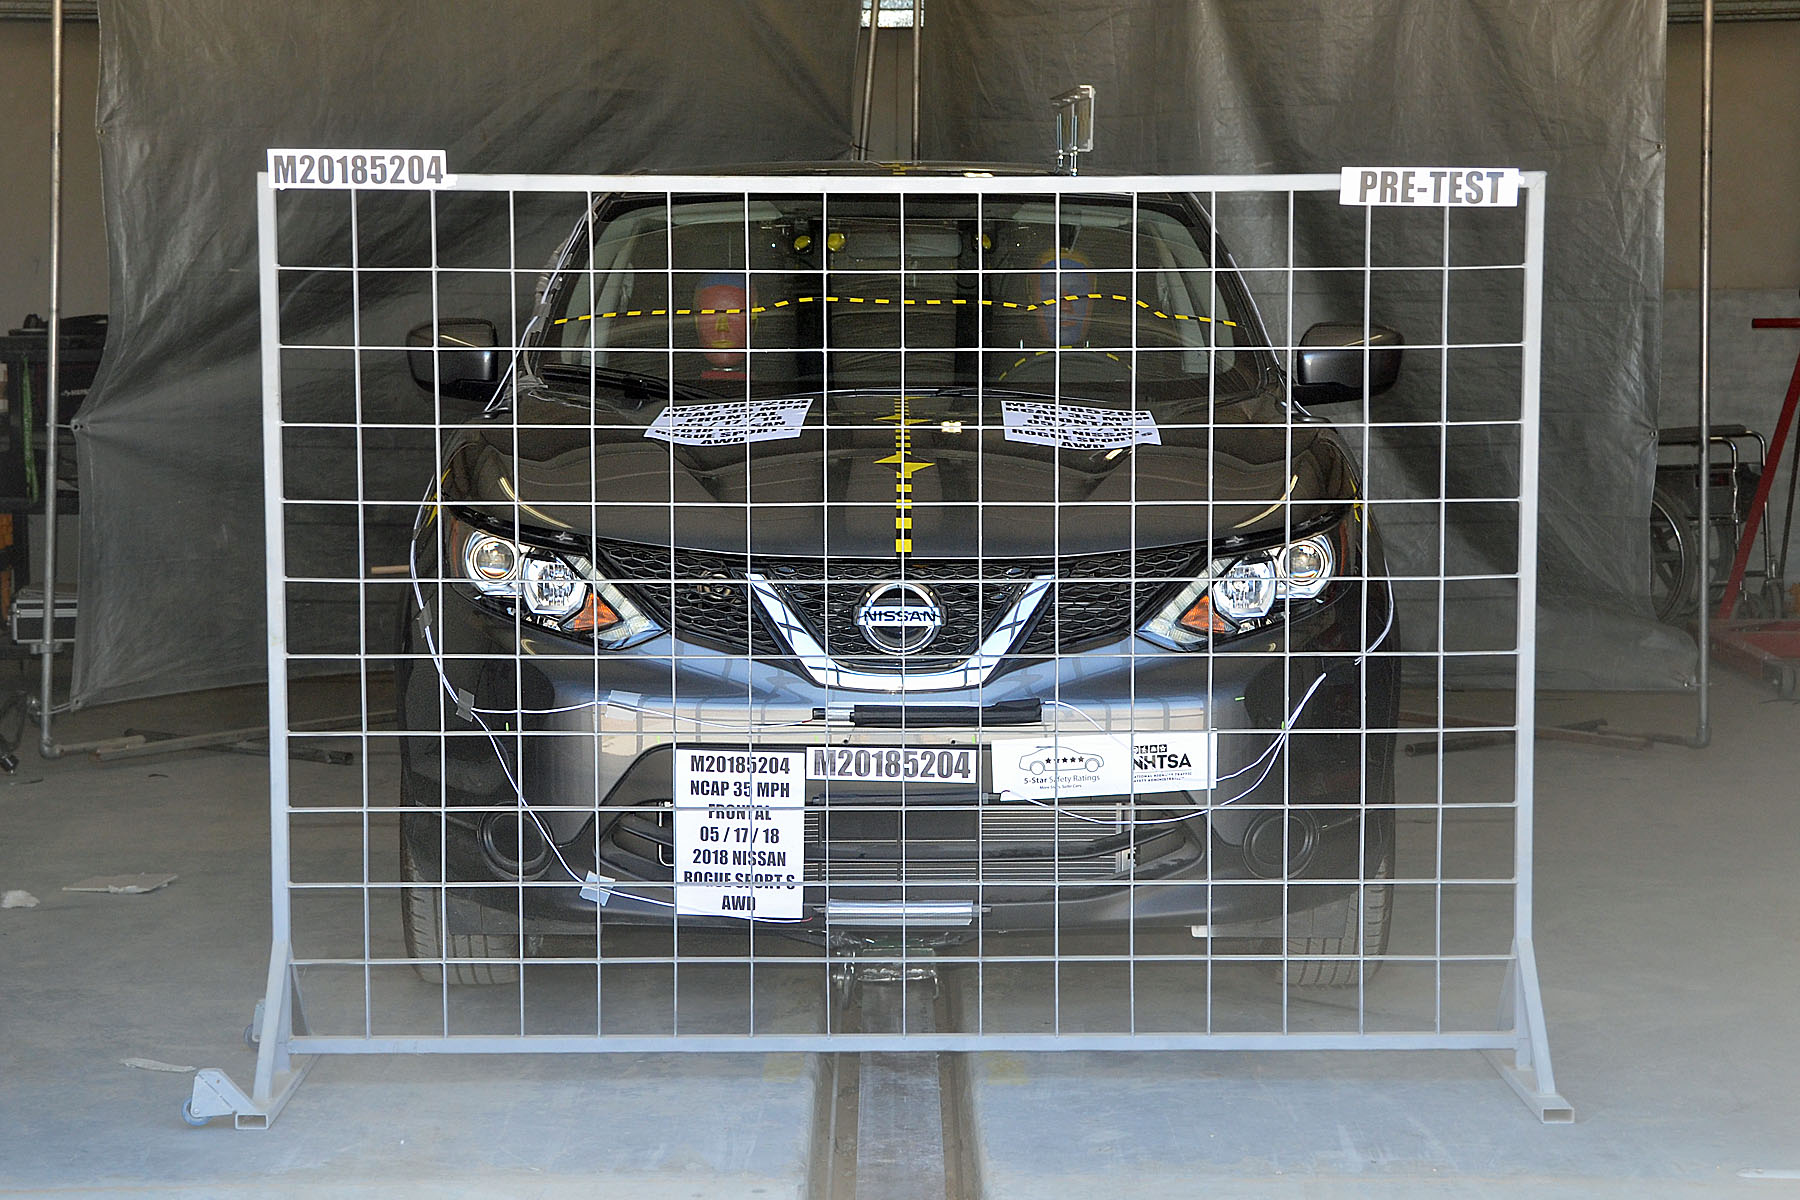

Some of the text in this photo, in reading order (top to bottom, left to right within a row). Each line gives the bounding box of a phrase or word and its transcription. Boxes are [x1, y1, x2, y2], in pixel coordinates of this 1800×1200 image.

[273, 154, 443, 185] M20185204
[1358, 171, 1504, 204] PRE-TEST
[864, 611, 936, 621] NISSAN
[691, 755, 790, 774] M20185204
[813, 749, 971, 778] M20185204
[1132, 754, 1192, 770] NHTSA
[1024, 776, 1047, 785] 5-Star
[1073, 774, 1101, 783] Ratings
[690, 780, 790, 798] NCAP 35 MPH
[700, 826, 719, 842] 05
[734, 827, 748, 843] 17
[763, 828, 780, 844] 18
[692, 848, 786, 867] 2018 NISSAN
[786, 874, 796, 890] S
[721, 895, 756, 911] AWD
